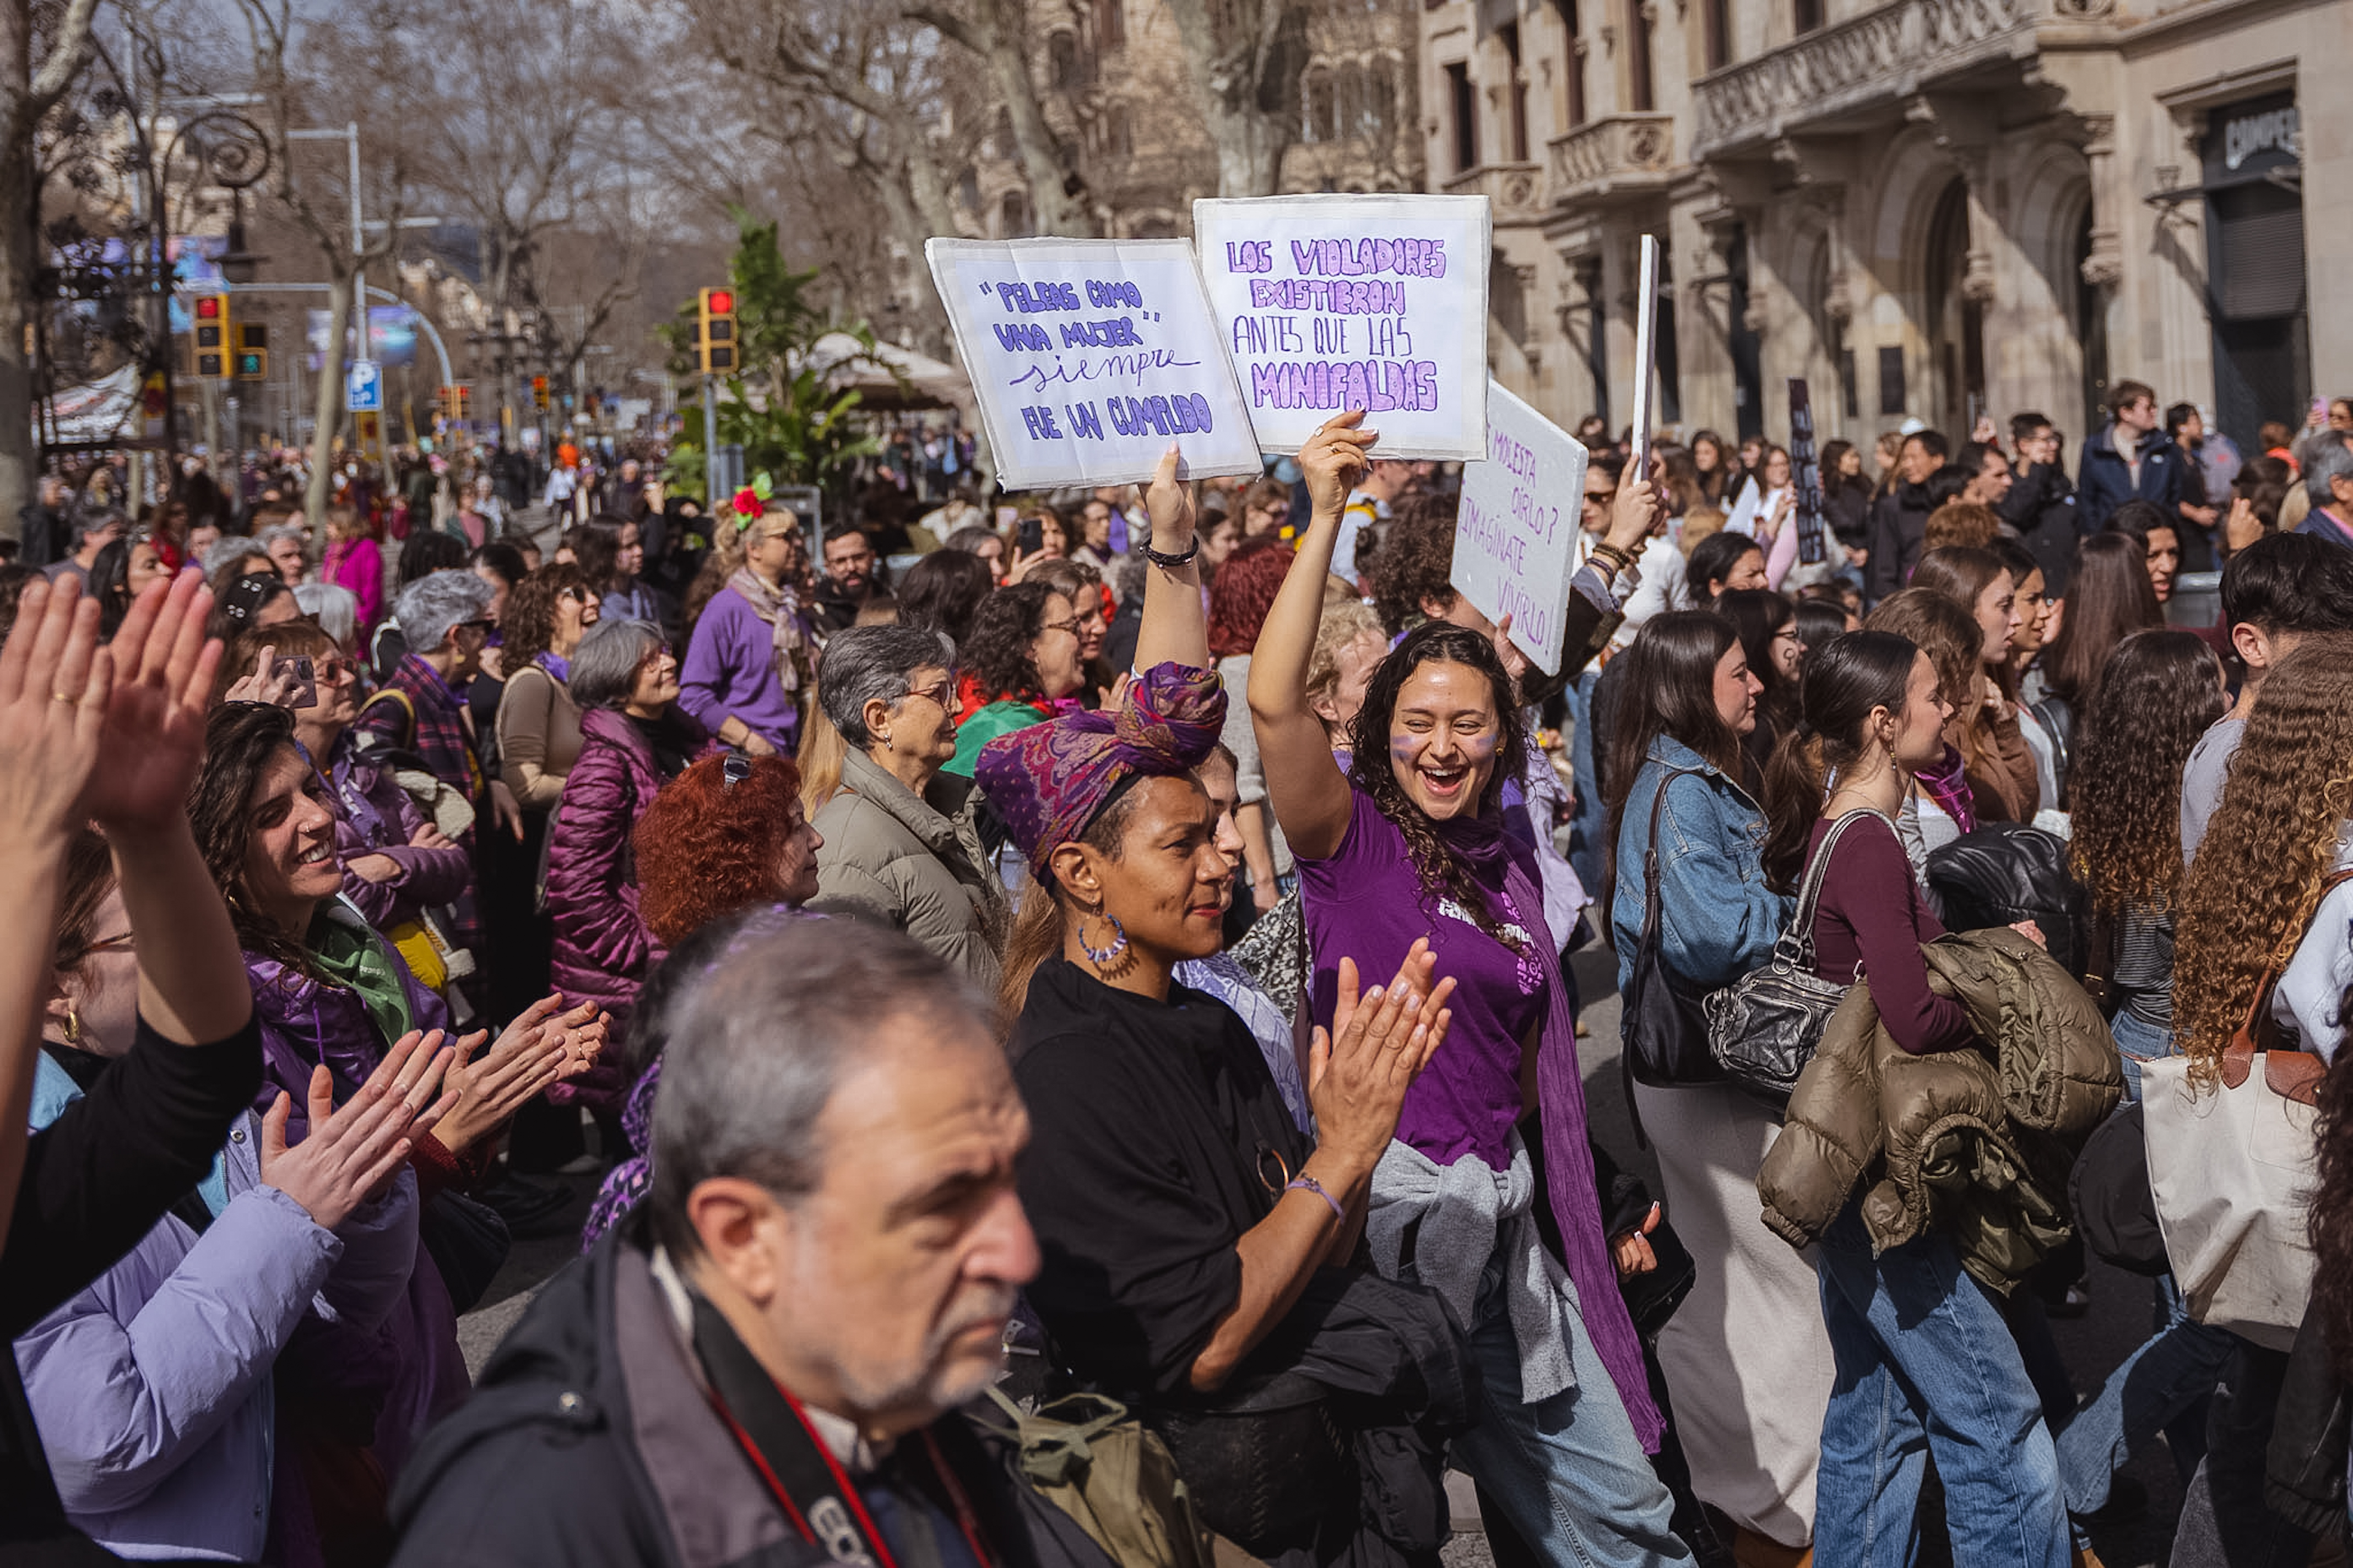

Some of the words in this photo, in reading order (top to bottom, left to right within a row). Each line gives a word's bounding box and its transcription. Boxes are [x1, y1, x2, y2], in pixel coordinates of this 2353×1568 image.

[1227, 240, 1272, 273] LOS
[1291, 238, 1446, 278] VIOLADORES
[1086, 279, 1142, 308] COMO
[1250, 279, 1405, 314] EXISTIERON
[993, 323, 1053, 351] UNA
[1233, 315, 1303, 354] ANTES
[1314, 317, 1349, 355] QUE
[1368, 317, 1412, 356] LAS
[1010, 349, 1201, 393] siempre
[1251, 360, 1437, 411] MINIFALDAS
[1020, 405, 1063, 440] FUE
[1065, 401, 1104, 441] UN
[1107, 393, 1212, 435] CUMPLIDO
[1493, 429, 1536, 488] MOLESTA
[808, 1495, 877, 1568] EO
